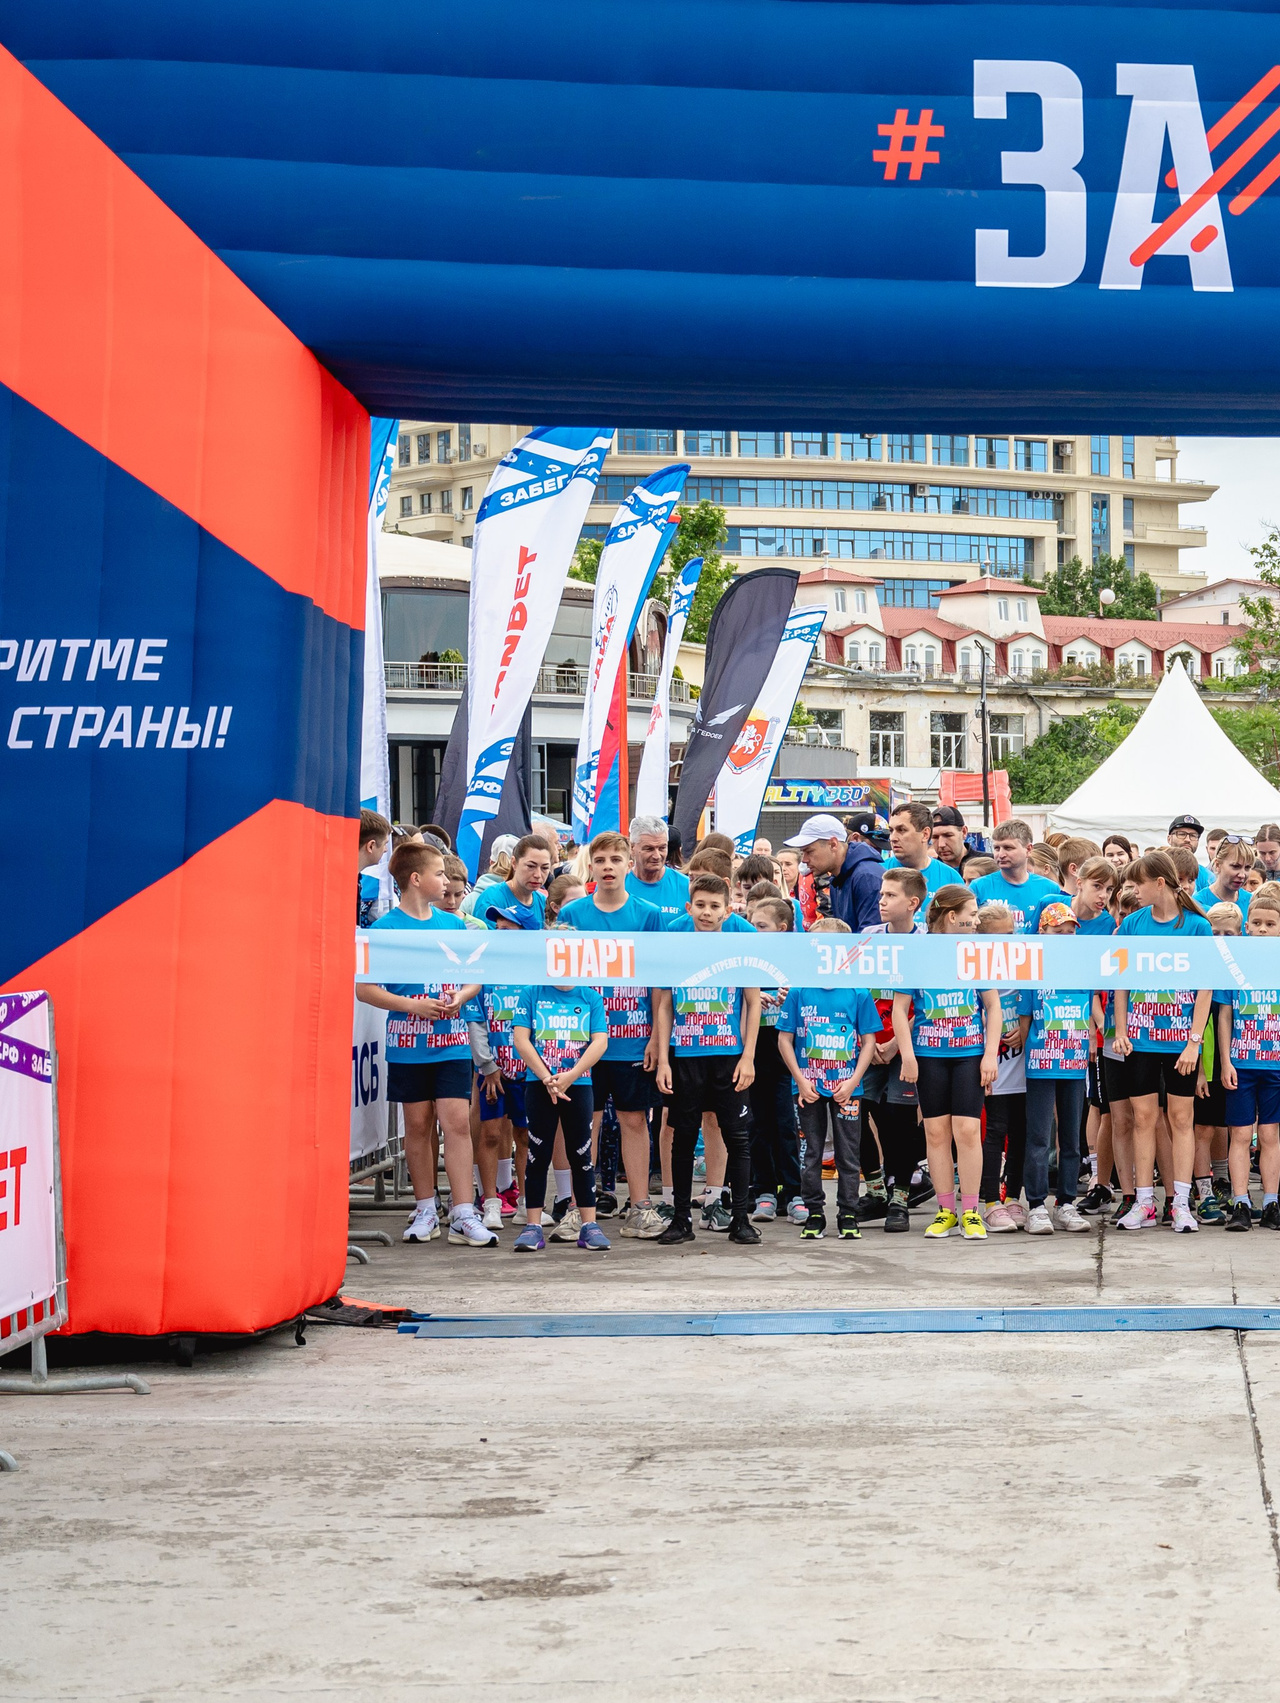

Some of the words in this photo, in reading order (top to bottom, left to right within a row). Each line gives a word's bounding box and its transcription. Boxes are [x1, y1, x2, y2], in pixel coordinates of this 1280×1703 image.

[7, 705, 233, 749] СТРАНЫ!
[546, 938, 635, 978] СТАРТ
[957, 941, 1043, 981] СТАРТ
[1136, 952, 1190, 973] ПСБ
[686, 987, 718, 1001] 10003
[936, 991, 965, 1007] 10172
[1250, 989, 1277, 1004] 10143
[1053, 1005, 1082, 1019] 10255
[1132, 1002, 1183, 1017] #ГОРДОСТЬ
[548, 1015, 578, 1029] 10013
[815, 1034, 846, 1049] 10068
[1241, 1029, 1280, 1041] #ГОРДОСТЬ
